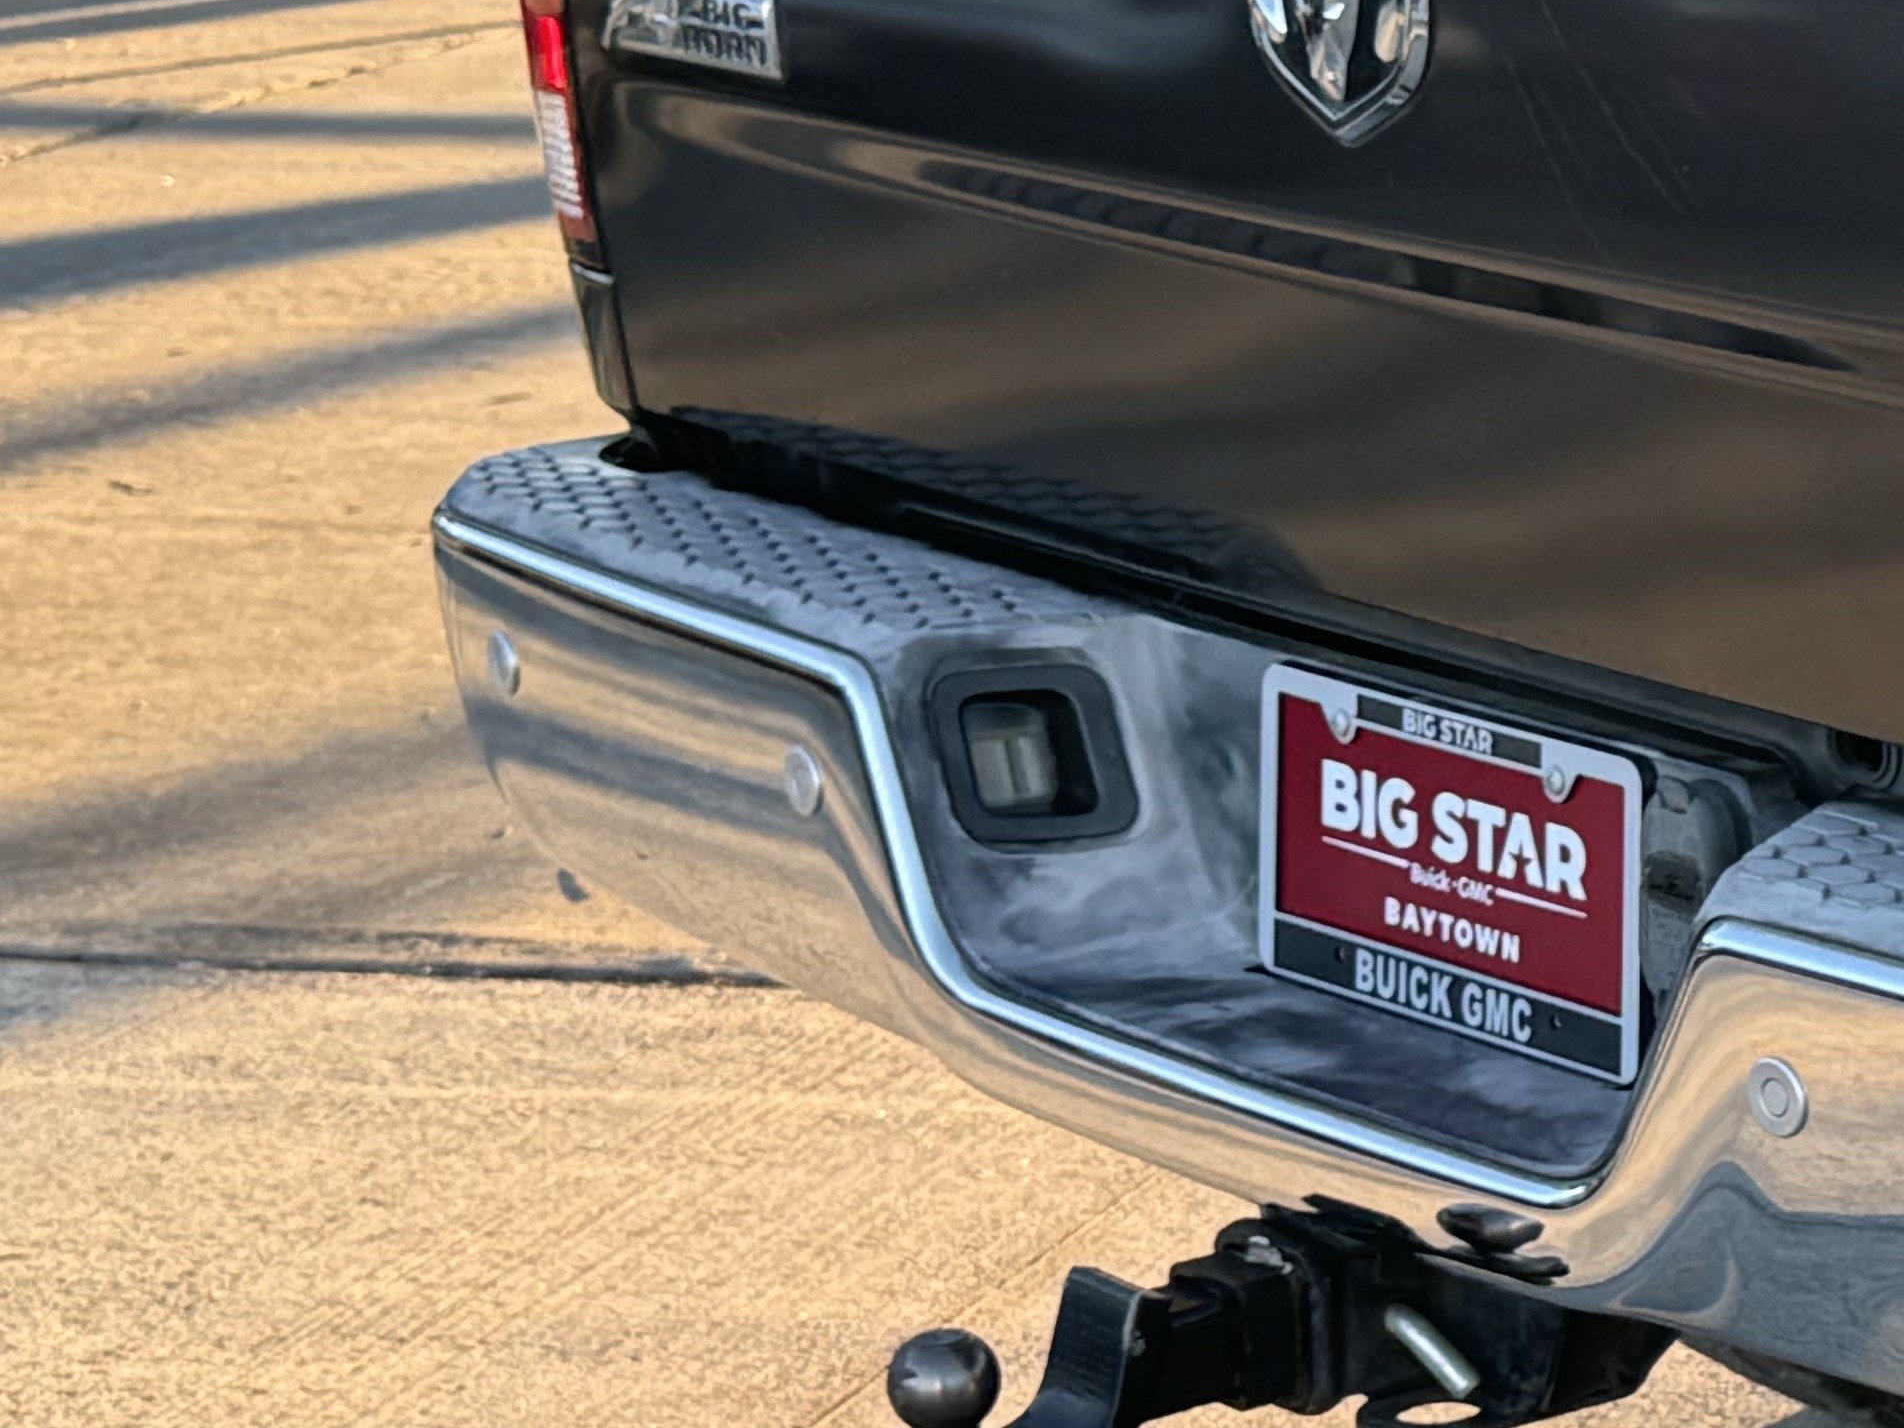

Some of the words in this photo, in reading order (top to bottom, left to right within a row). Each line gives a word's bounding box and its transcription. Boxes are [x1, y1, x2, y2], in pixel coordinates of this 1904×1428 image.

[1401, 707, 1437, 739] BIG
[1440, 721, 1493, 756] STAR
[1320, 758, 1419, 849] BIG
[1431, 791, 1587, 902] STAR
[1383, 895, 1520, 964] BAYTOWN
[1355, 950, 1454, 1020] BUICK
[1460, 980, 1533, 1044] GMC
